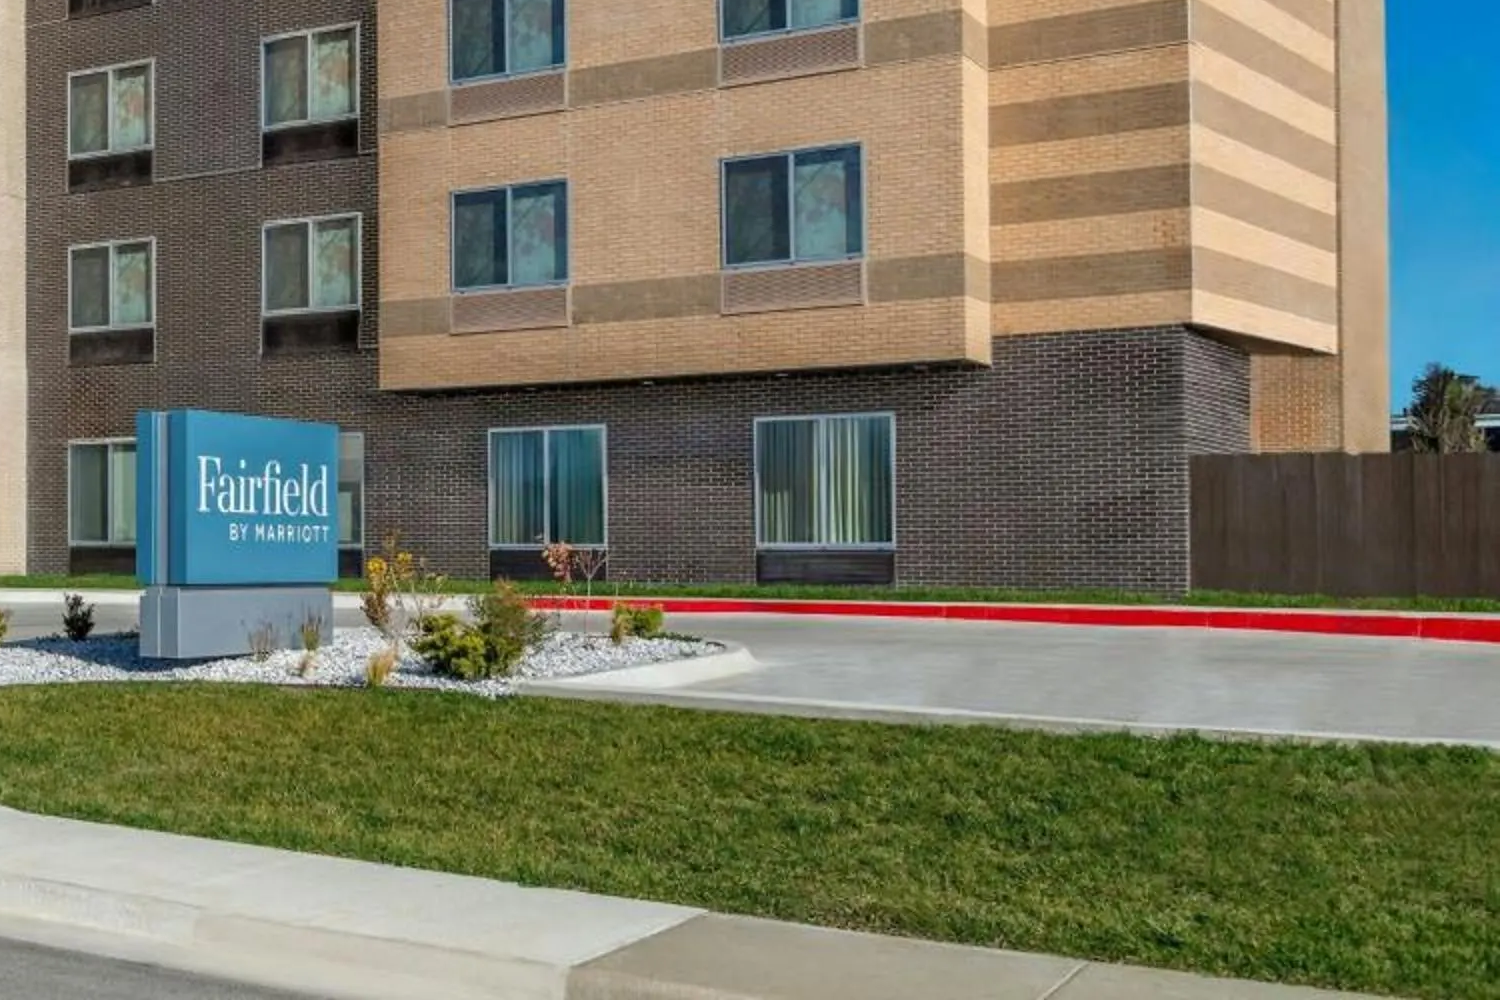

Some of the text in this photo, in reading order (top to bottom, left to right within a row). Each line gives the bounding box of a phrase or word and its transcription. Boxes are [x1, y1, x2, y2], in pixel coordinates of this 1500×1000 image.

[197, 455, 331, 517] Fairfield
[229, 523, 330, 543] BY MARRIOTT
